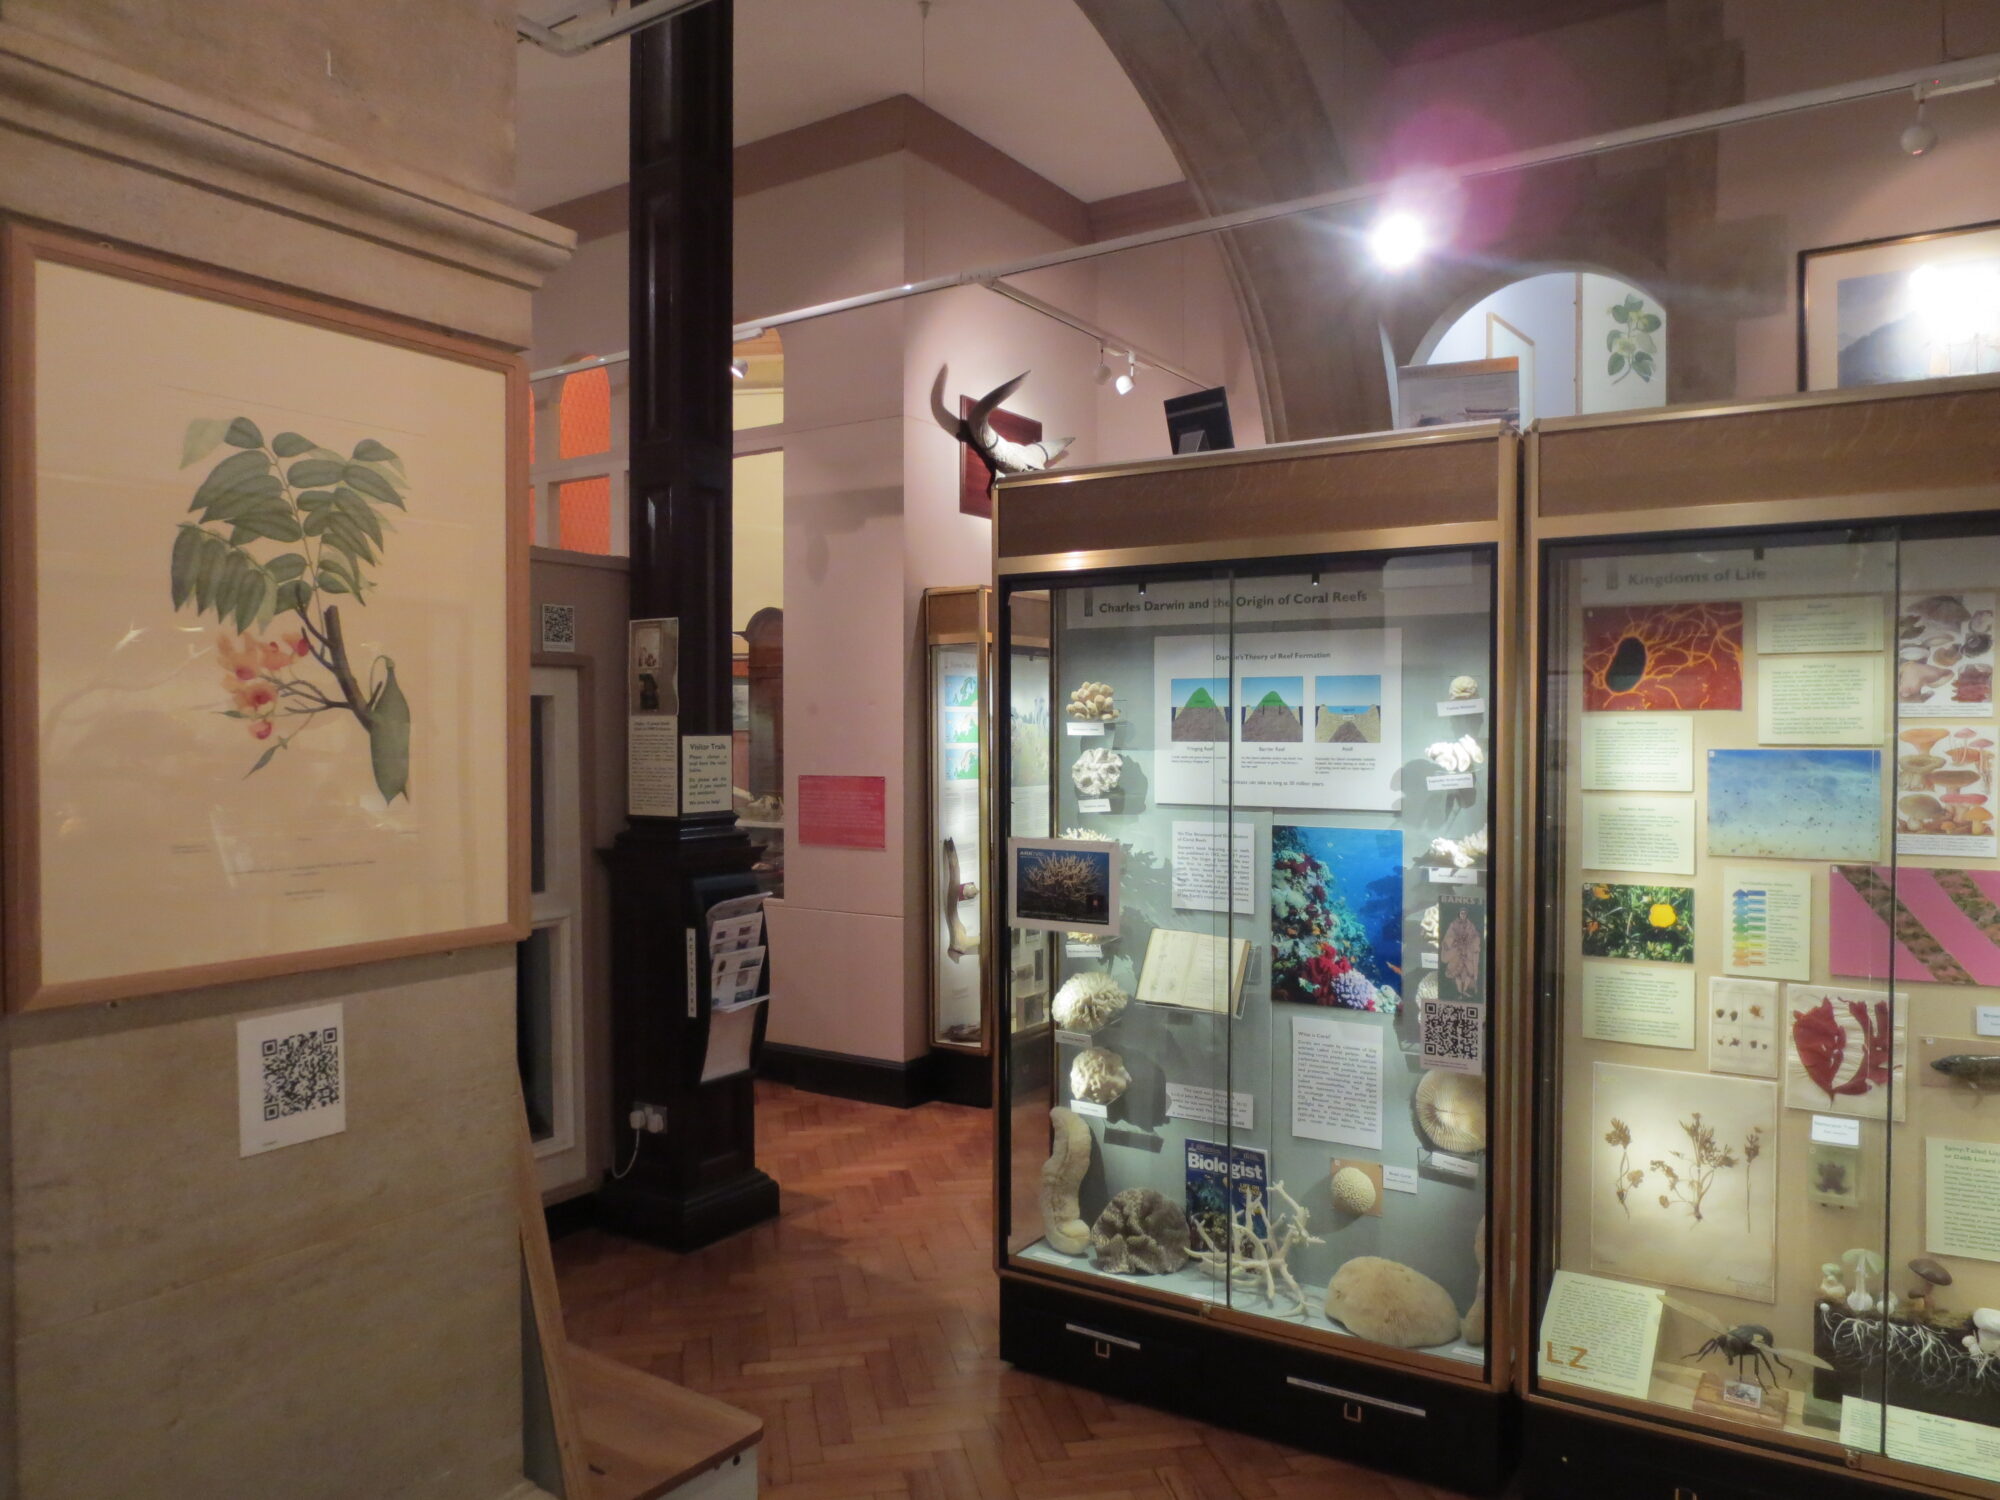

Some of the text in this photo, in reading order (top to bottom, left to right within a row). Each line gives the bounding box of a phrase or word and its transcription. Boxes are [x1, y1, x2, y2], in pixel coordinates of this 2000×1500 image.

[1628, 568, 1768, 587] Kingdoms of Life
[1099, 590, 1368, 613] Charles Darwin and the Origin of Coral Reefs
[1245, 653, 1268, 662] Theory
[1270, 652, 1277, 660] of
[1278, 652, 1294, 660] Reef
[1294, 651, 1331, 660] Formation
[1187, 1152, 1263, 1180] Biologist
